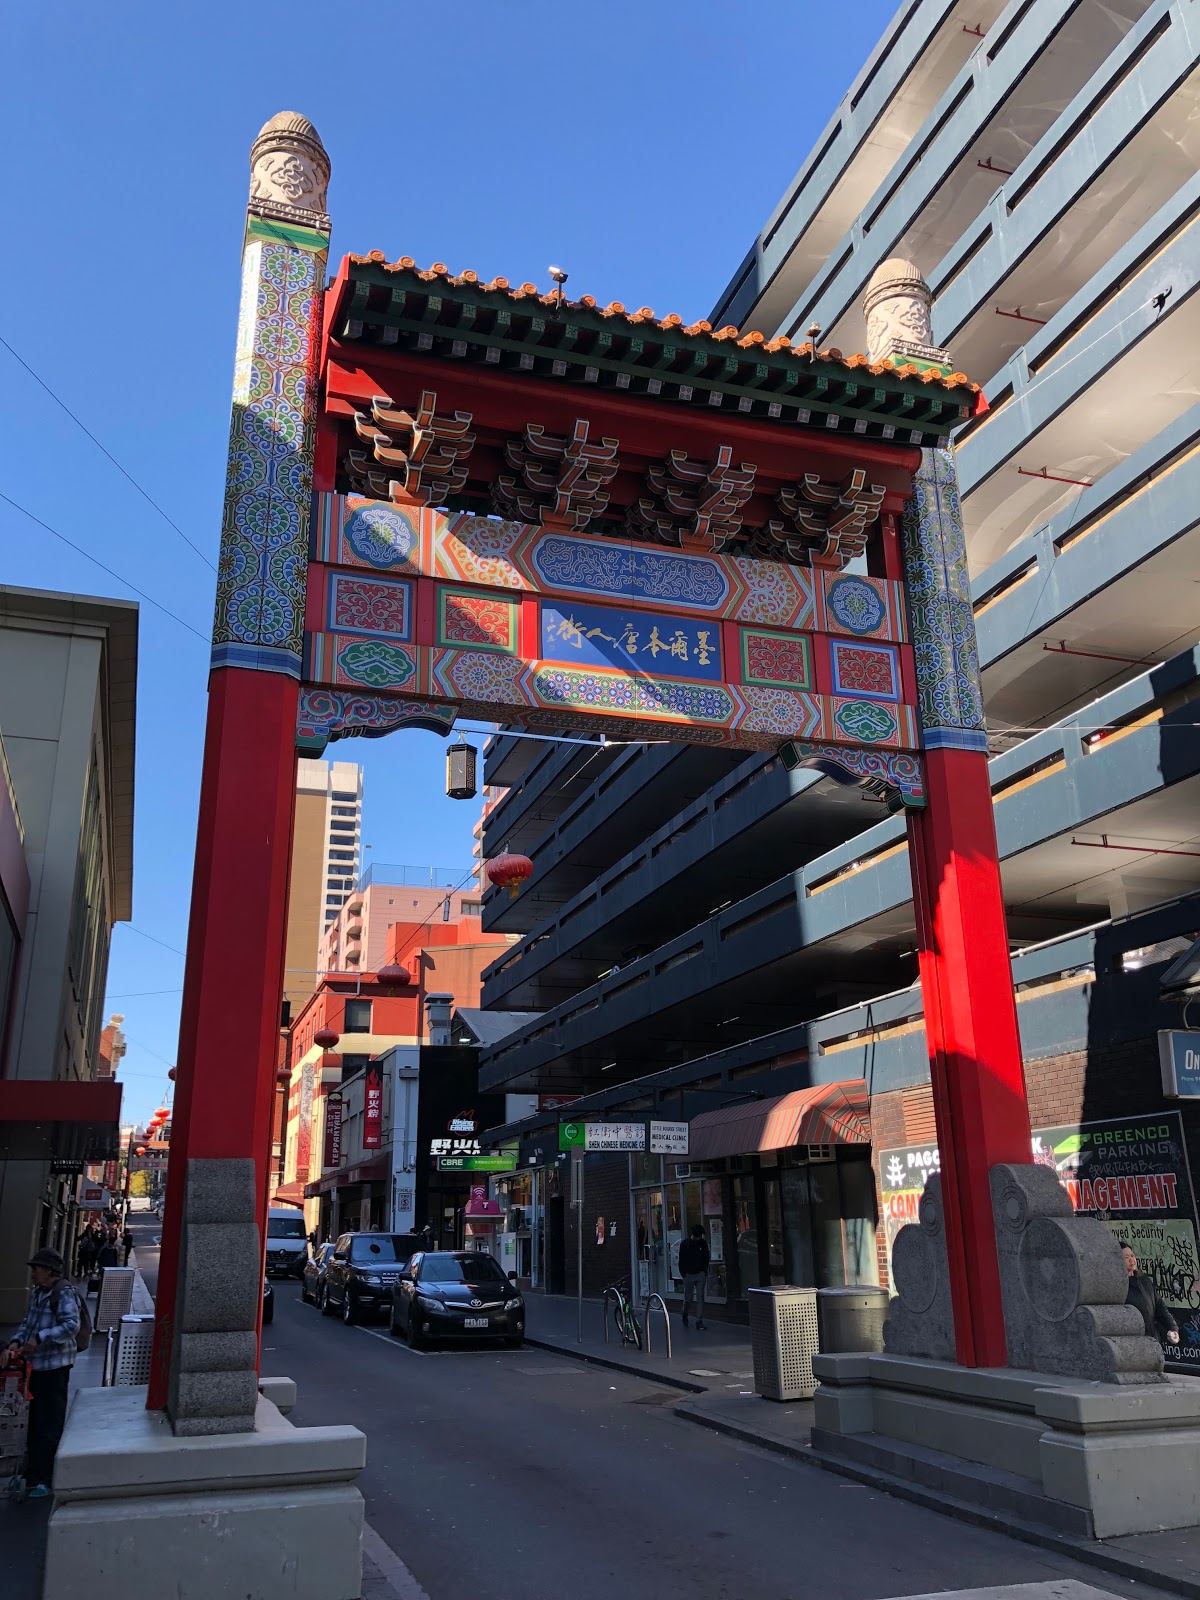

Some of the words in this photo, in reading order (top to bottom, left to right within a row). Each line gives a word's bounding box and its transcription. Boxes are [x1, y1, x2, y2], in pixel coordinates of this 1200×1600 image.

[332, 1111, 341, 1164] TEPPANYAKI
[651, 1133, 671, 1141] MEDICAL
[672, 1134, 687, 1142] CLINIC
[1093, 1125, 1169, 1144] GREENCO
[588, 1141, 600, 1149] SHEN
[601, 1140, 618, 1149] CHINESE
[619, 1140, 638, 1149] MEDICINE
[1098, 1141, 1169, 1159] PARKING
[1131, 1225, 1164, 1242] Security
